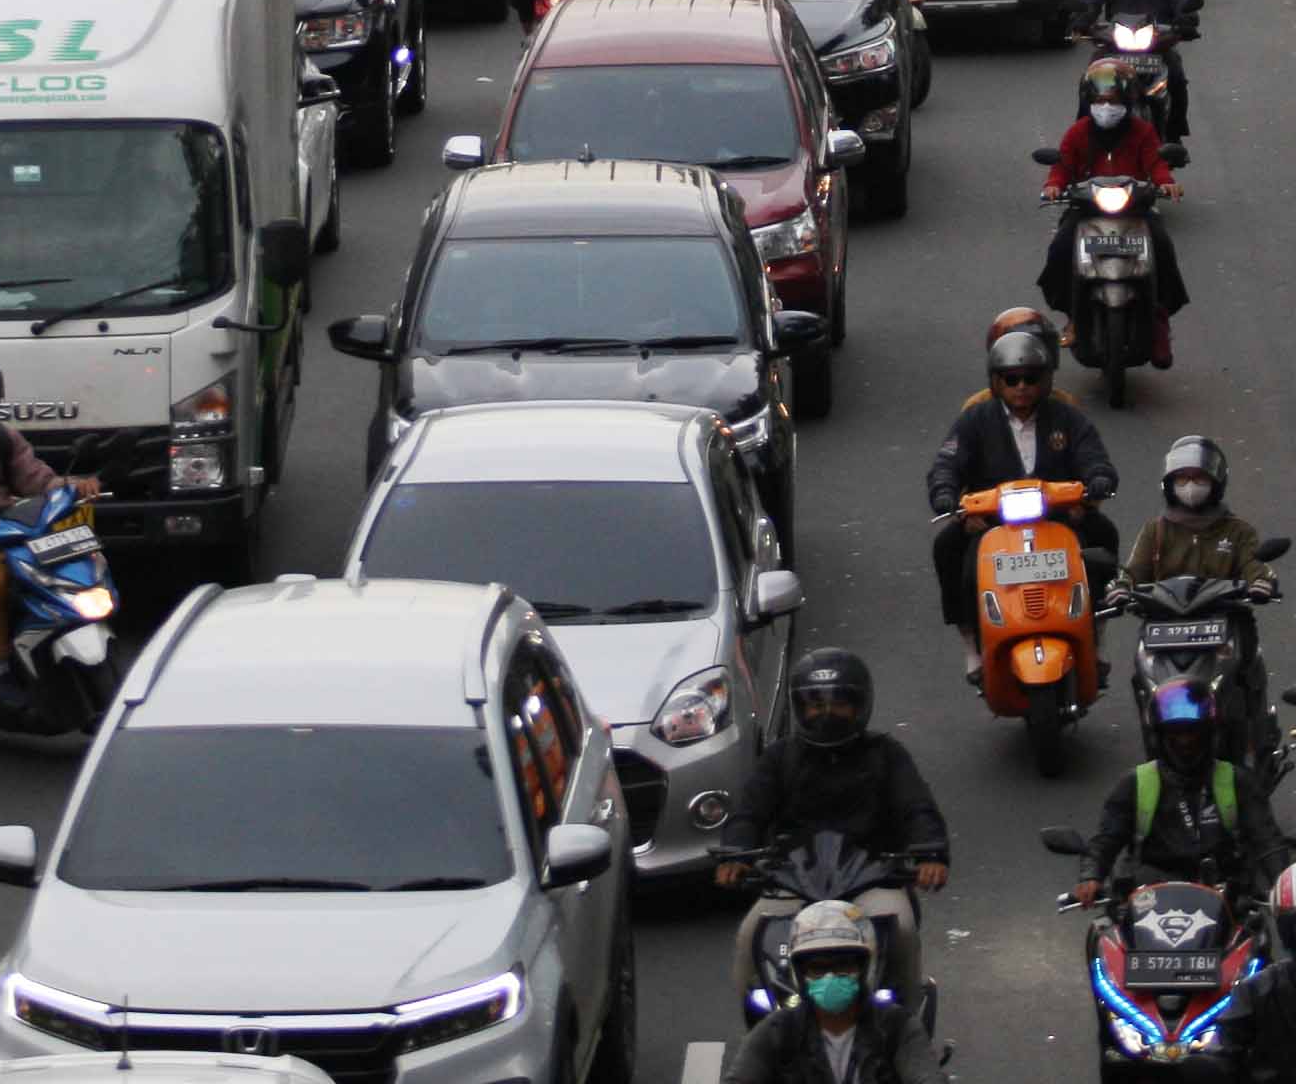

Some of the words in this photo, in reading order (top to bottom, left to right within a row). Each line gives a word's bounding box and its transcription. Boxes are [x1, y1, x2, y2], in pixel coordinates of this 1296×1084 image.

[112, 346, 163, 357] NLR
[995, 557, 1003, 572] B
[1130, 956, 1140, 971] B
[1147, 956, 1182, 971] 5723
